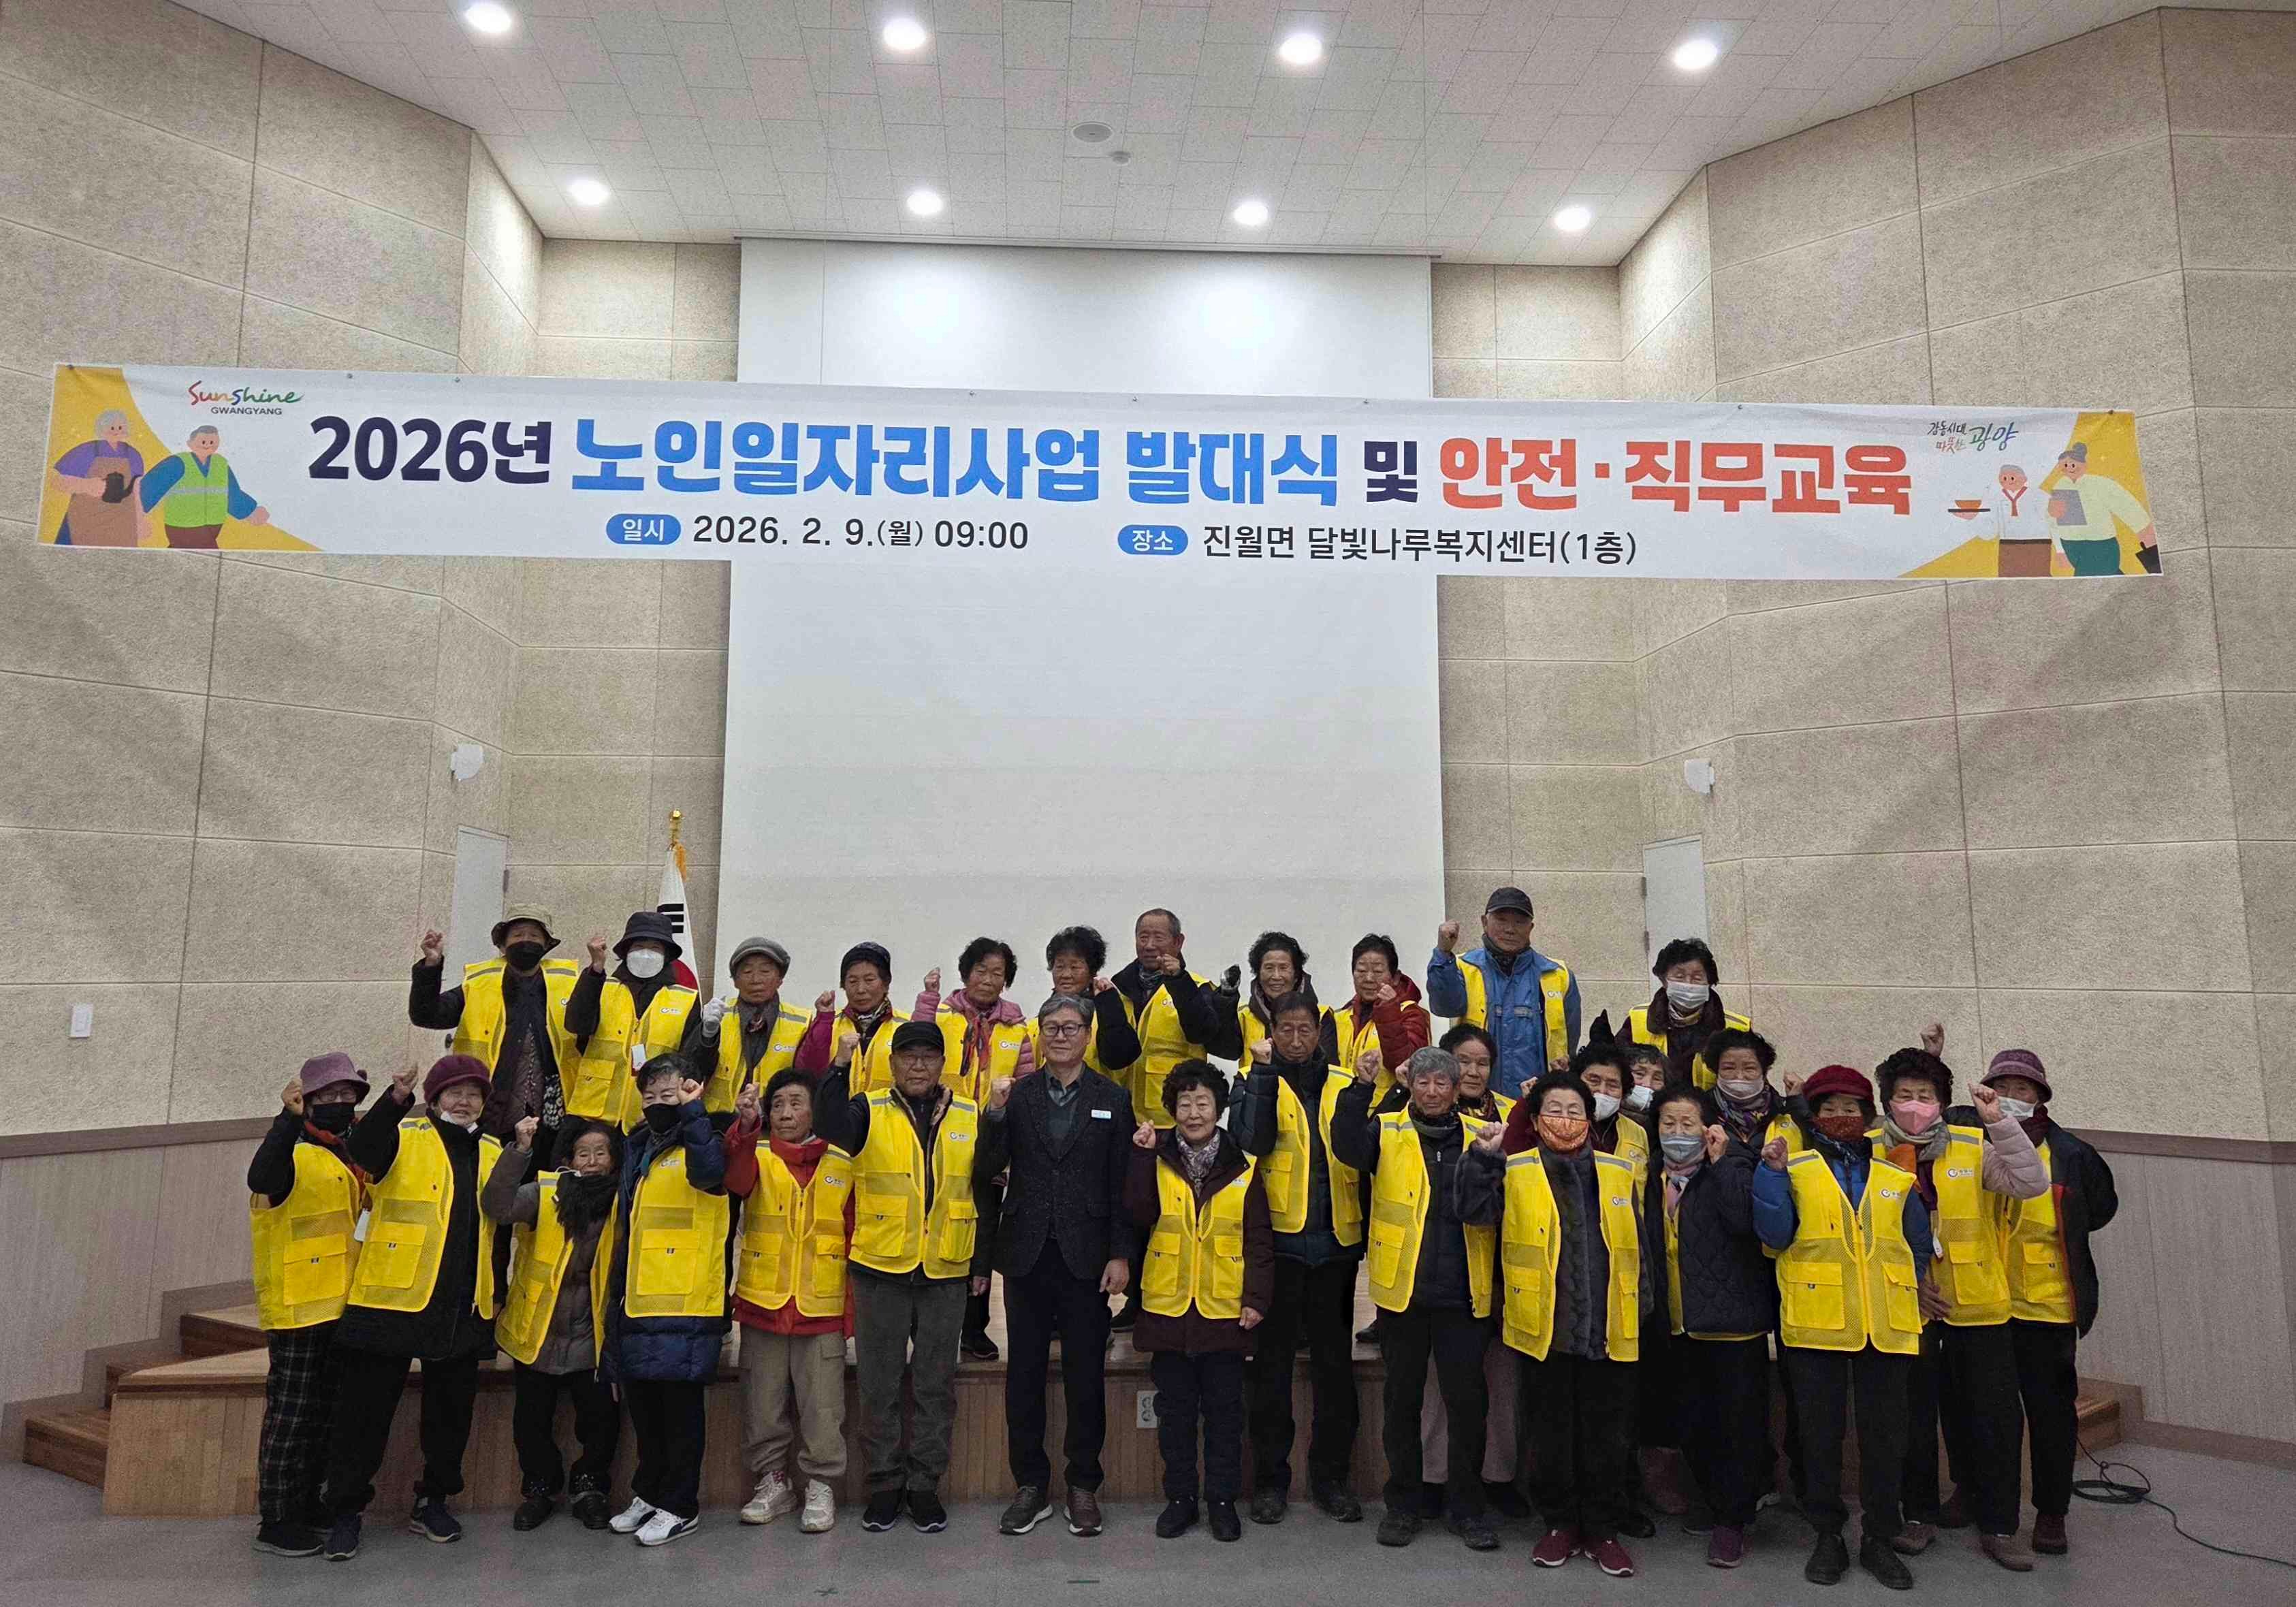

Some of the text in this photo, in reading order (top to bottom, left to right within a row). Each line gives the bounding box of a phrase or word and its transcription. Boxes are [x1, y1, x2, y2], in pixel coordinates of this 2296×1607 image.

[188, 380, 304, 405] Sunshine
[210, 407, 283, 415] GWANGYANG
[1968, 421, 2019, 451] 광양
[309, 416, 552, 484] 2026년
[572, 419, 1100, 502] 노인일자리사업
[1126, 431, 1338, 507] 발대식
[1364, 441, 1418, 503] 및
[622, 519, 664, 542] 일시
[693, 515, 788, 545] 2026.
[802, 517, 830, 546] 2.
[935, 520, 1028, 550] 09:00
[1132, 525, 1636, 565] 장소 진월면 달빛나루복지센터(1층)
